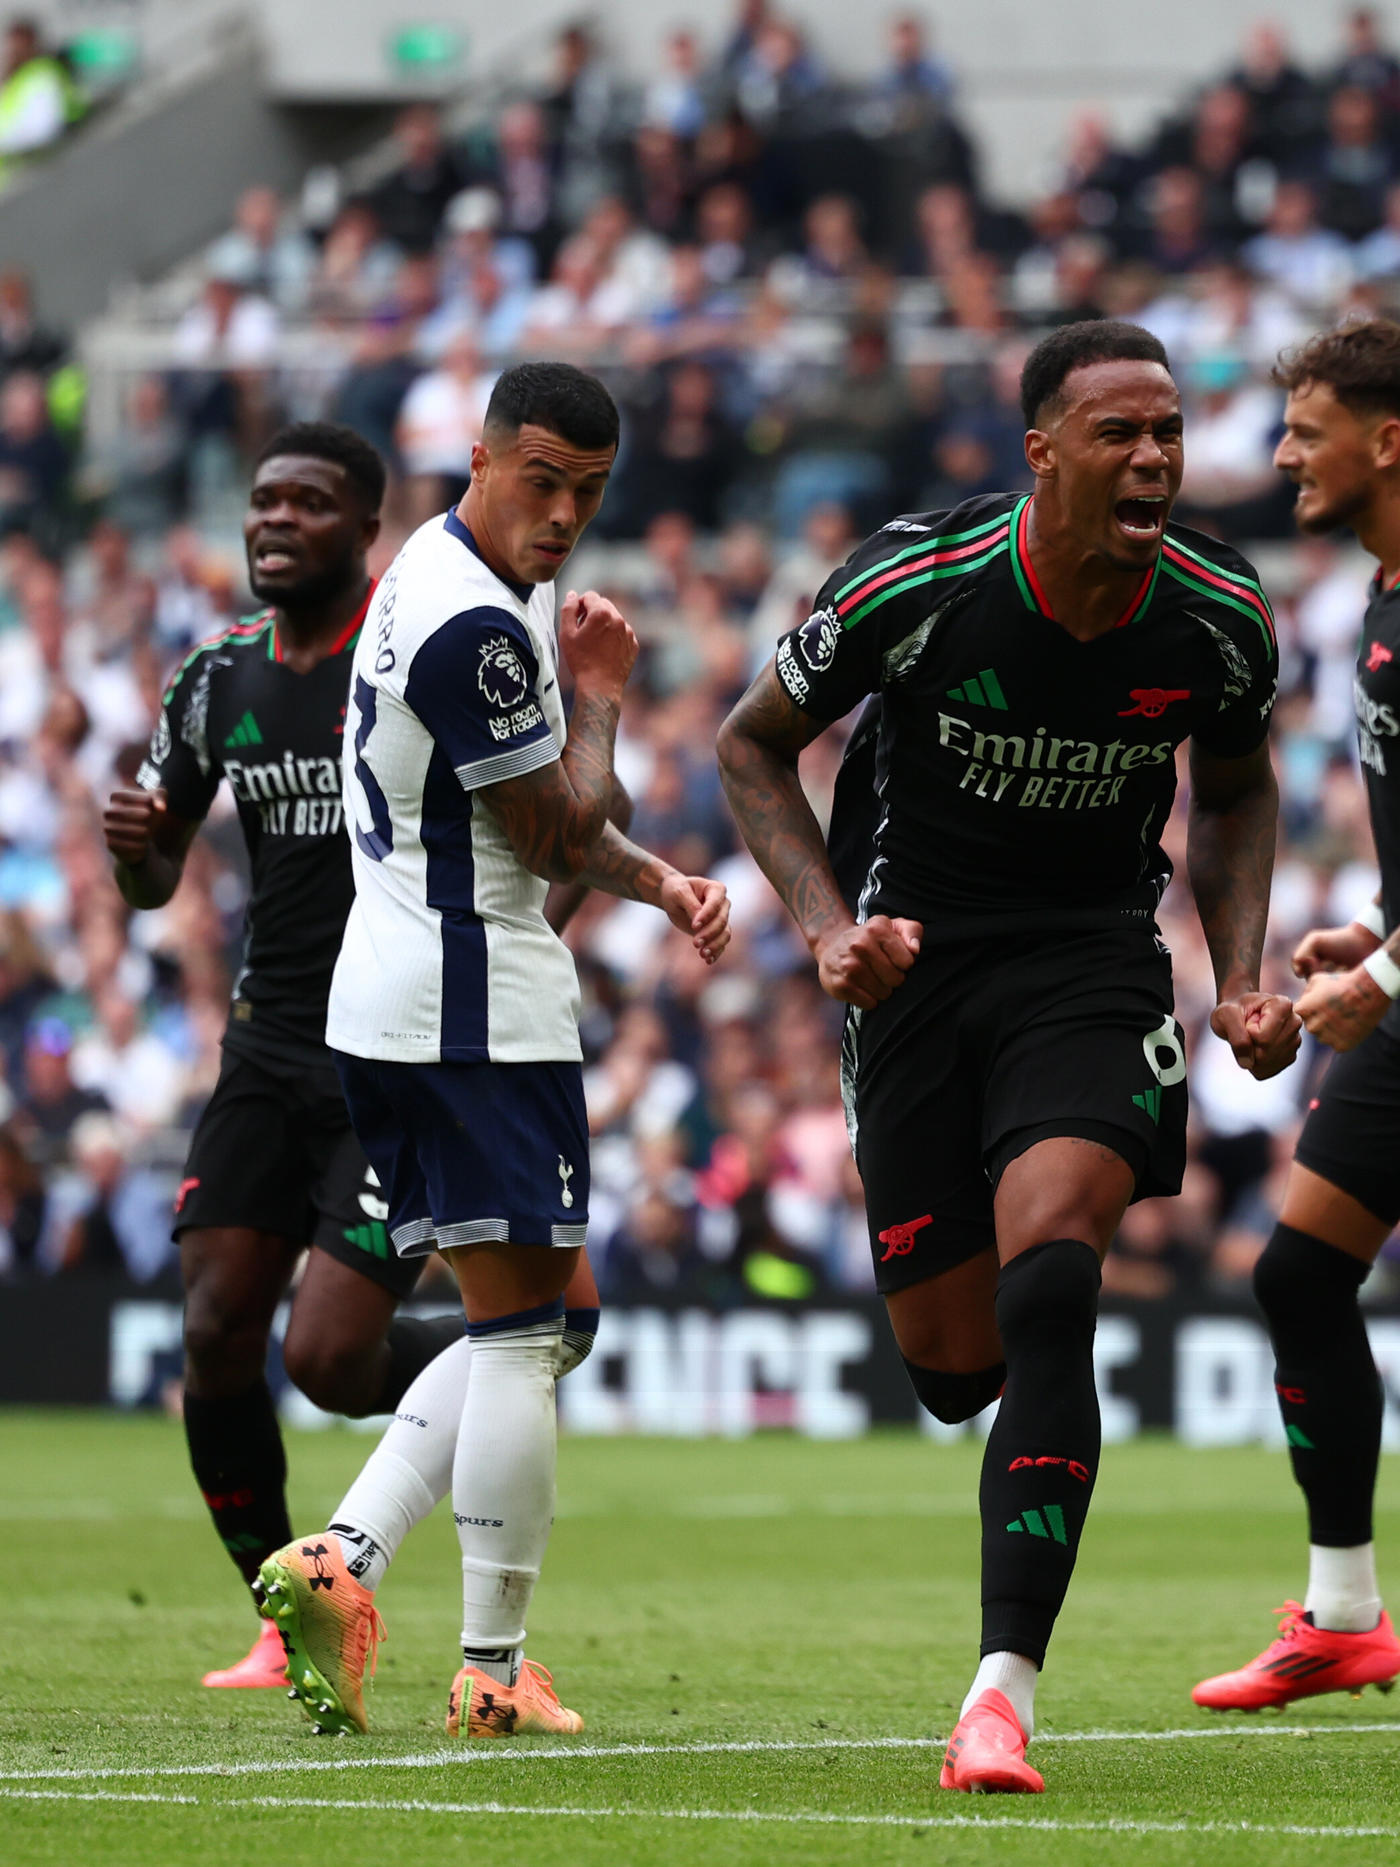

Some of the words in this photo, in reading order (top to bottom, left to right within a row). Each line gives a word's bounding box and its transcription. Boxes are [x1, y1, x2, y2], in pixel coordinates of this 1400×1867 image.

[786, 656, 810, 694] room
[488, 716, 510, 730] No
[510, 703, 538, 724] room
[493, 727, 511, 741] for
[512, 711, 543, 735] racism
[937, 711, 1172, 775] Emirates
[222, 749, 343, 802] Emira
[959, 762, 1016, 802] FLY
[1018, 773, 1127, 810] BETTER
[293, 797, 343, 835] BETT
[1142, 1013, 1187, 1087] 6
[1008, 1455, 1090, 1483] AFC
[453, 1511, 505, 1528] Spurs
